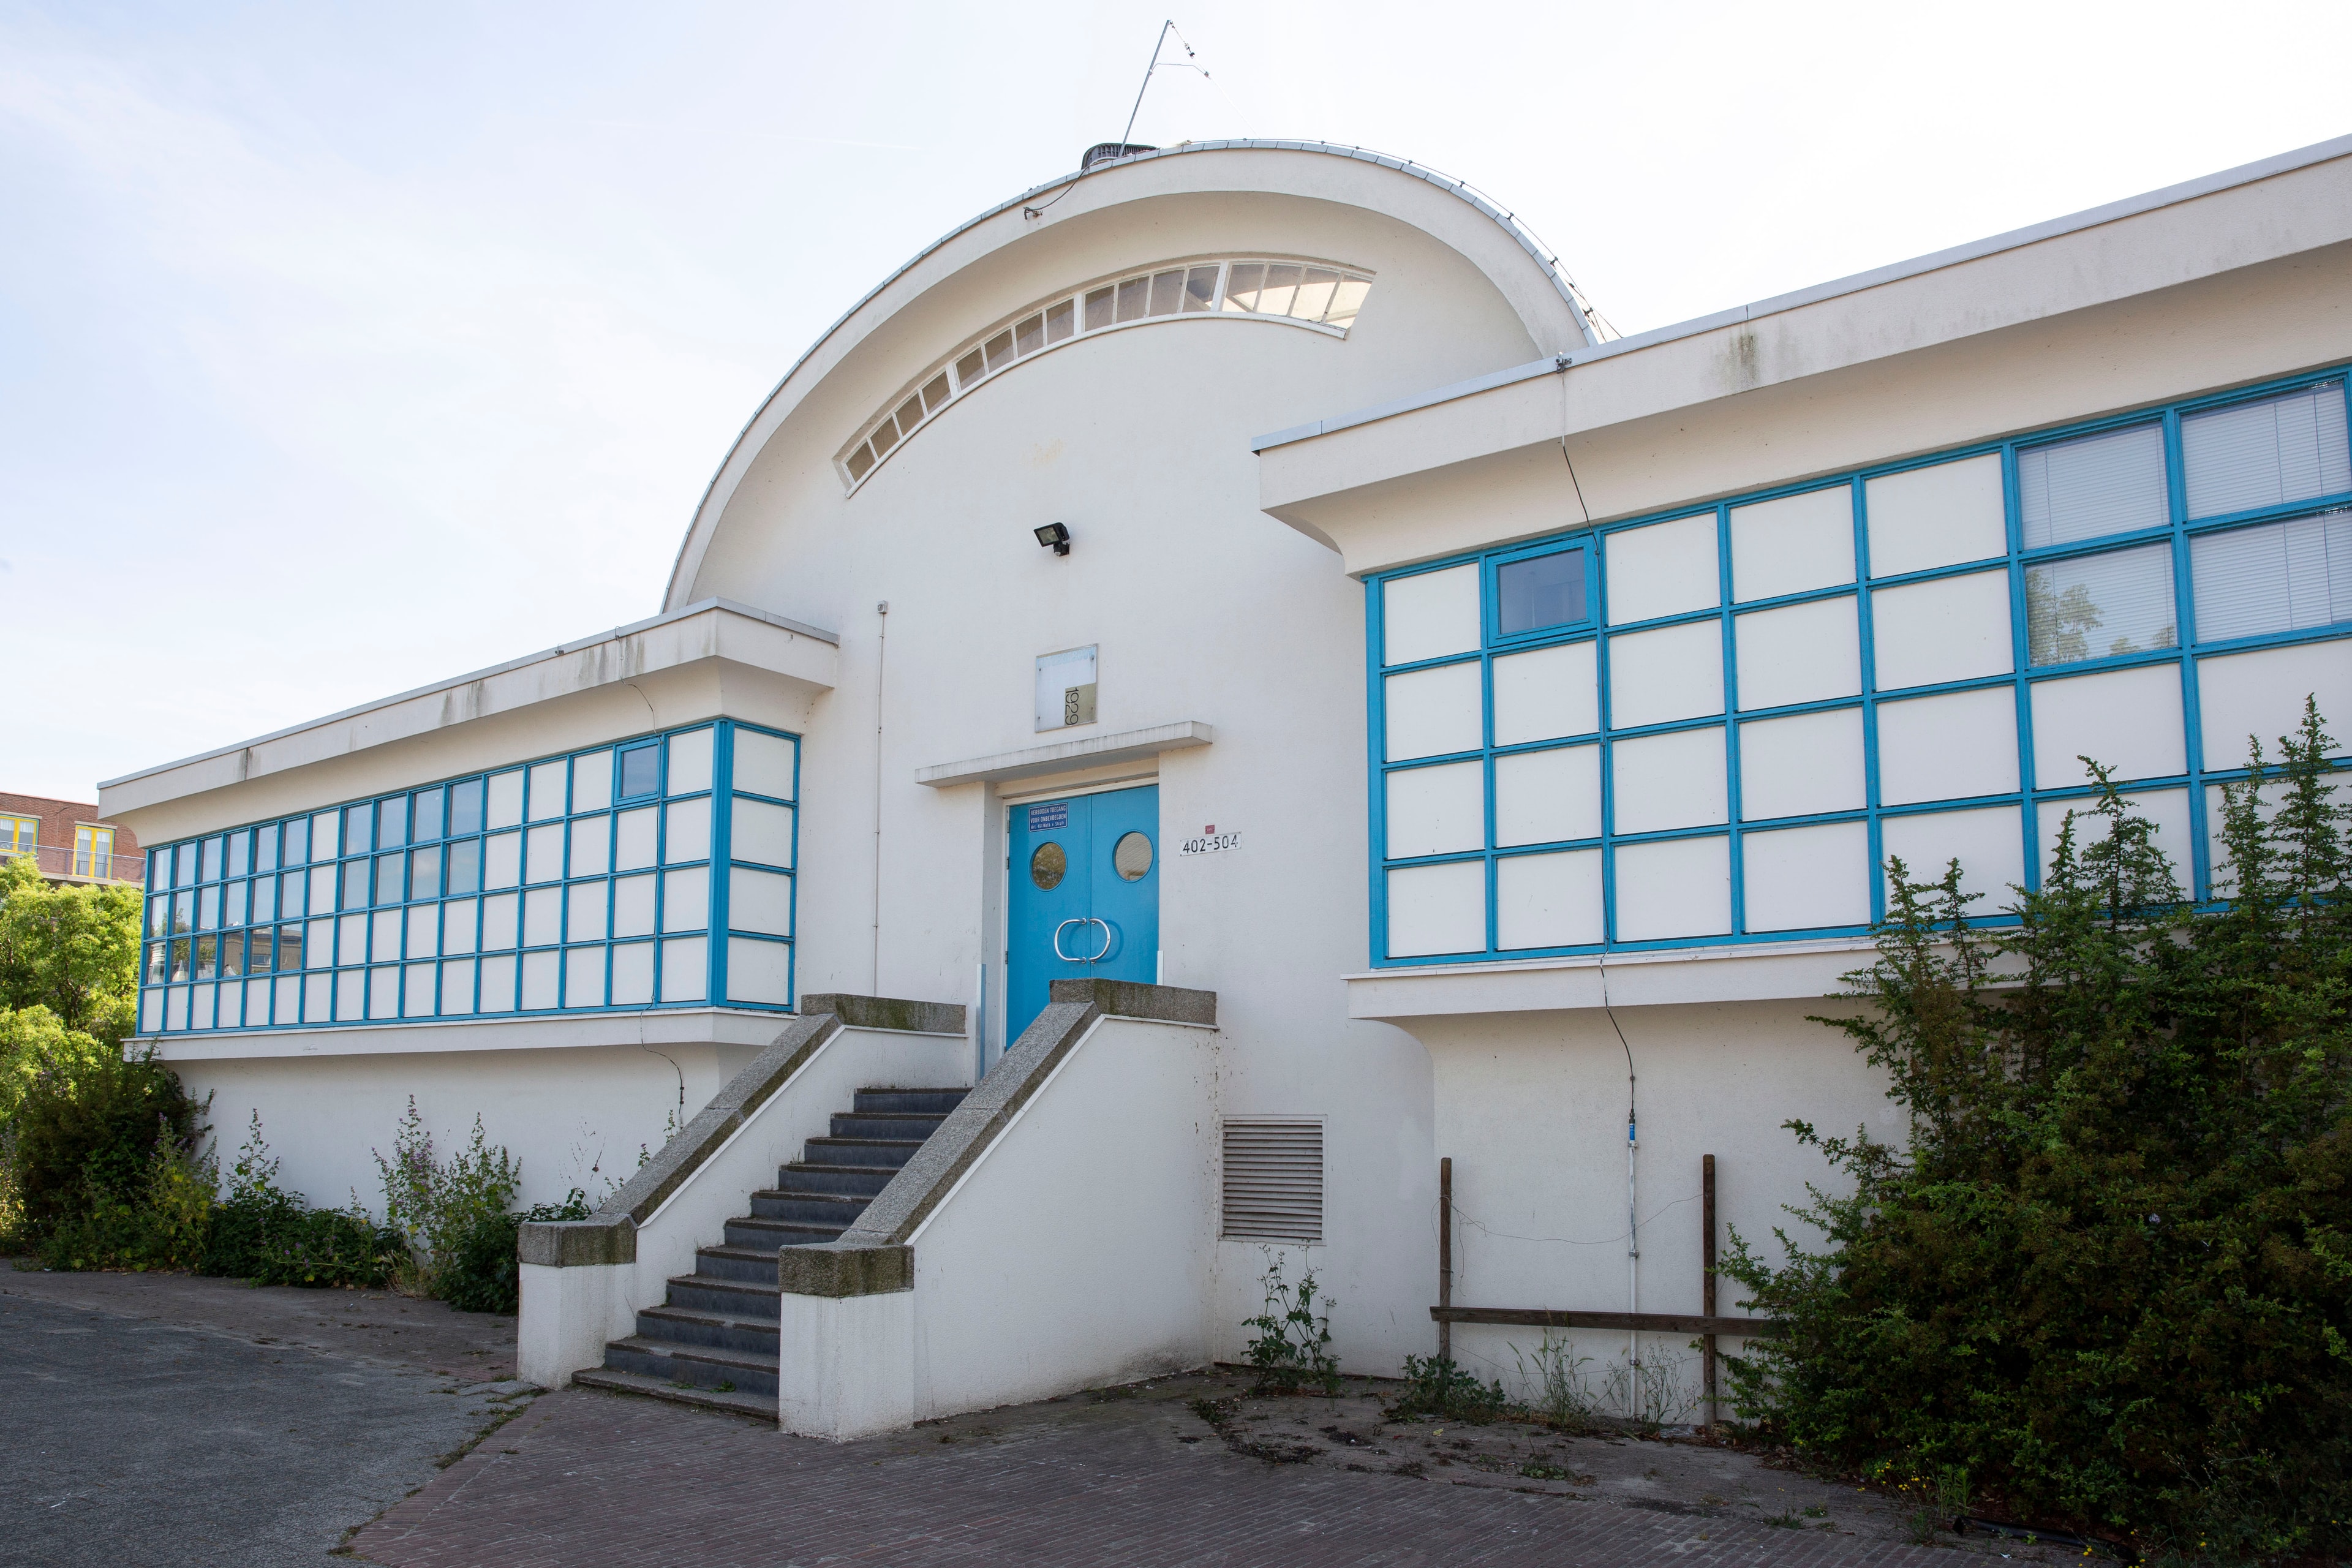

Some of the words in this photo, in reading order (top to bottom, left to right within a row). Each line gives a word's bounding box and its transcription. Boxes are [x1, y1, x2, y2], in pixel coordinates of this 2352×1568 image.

[1065, 687, 1079, 726] 1929
[1041, 813, 1066, 822] ONBEVOEGDEN
[1182, 834, 1238, 854] 402-504
